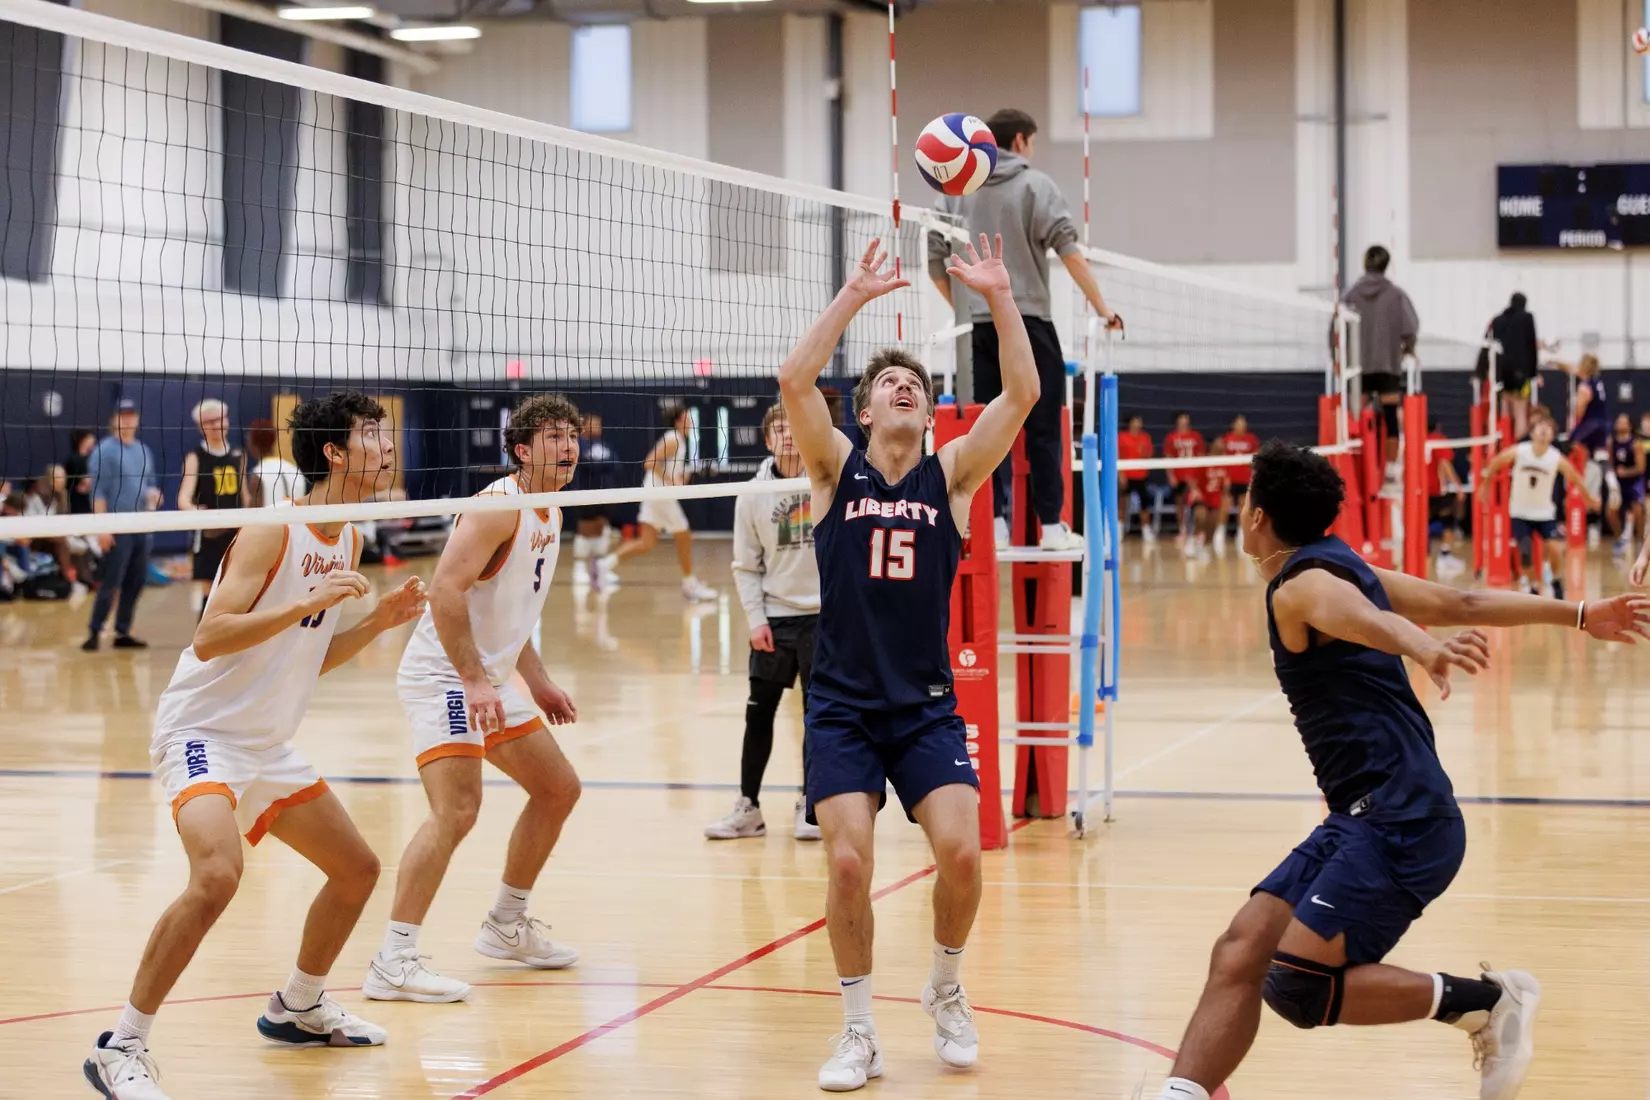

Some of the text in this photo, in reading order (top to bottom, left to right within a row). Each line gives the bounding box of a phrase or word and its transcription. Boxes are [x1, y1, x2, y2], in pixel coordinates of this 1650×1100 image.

[1499, 195, 1543, 217] HOME
[1617, 193, 1650, 215] GUE
[1558, 229, 1606, 247] PERIOD
[844, 497, 939, 527] LIBERTY
[869, 527, 917, 581] 15
[533, 558, 546, 594] 5
